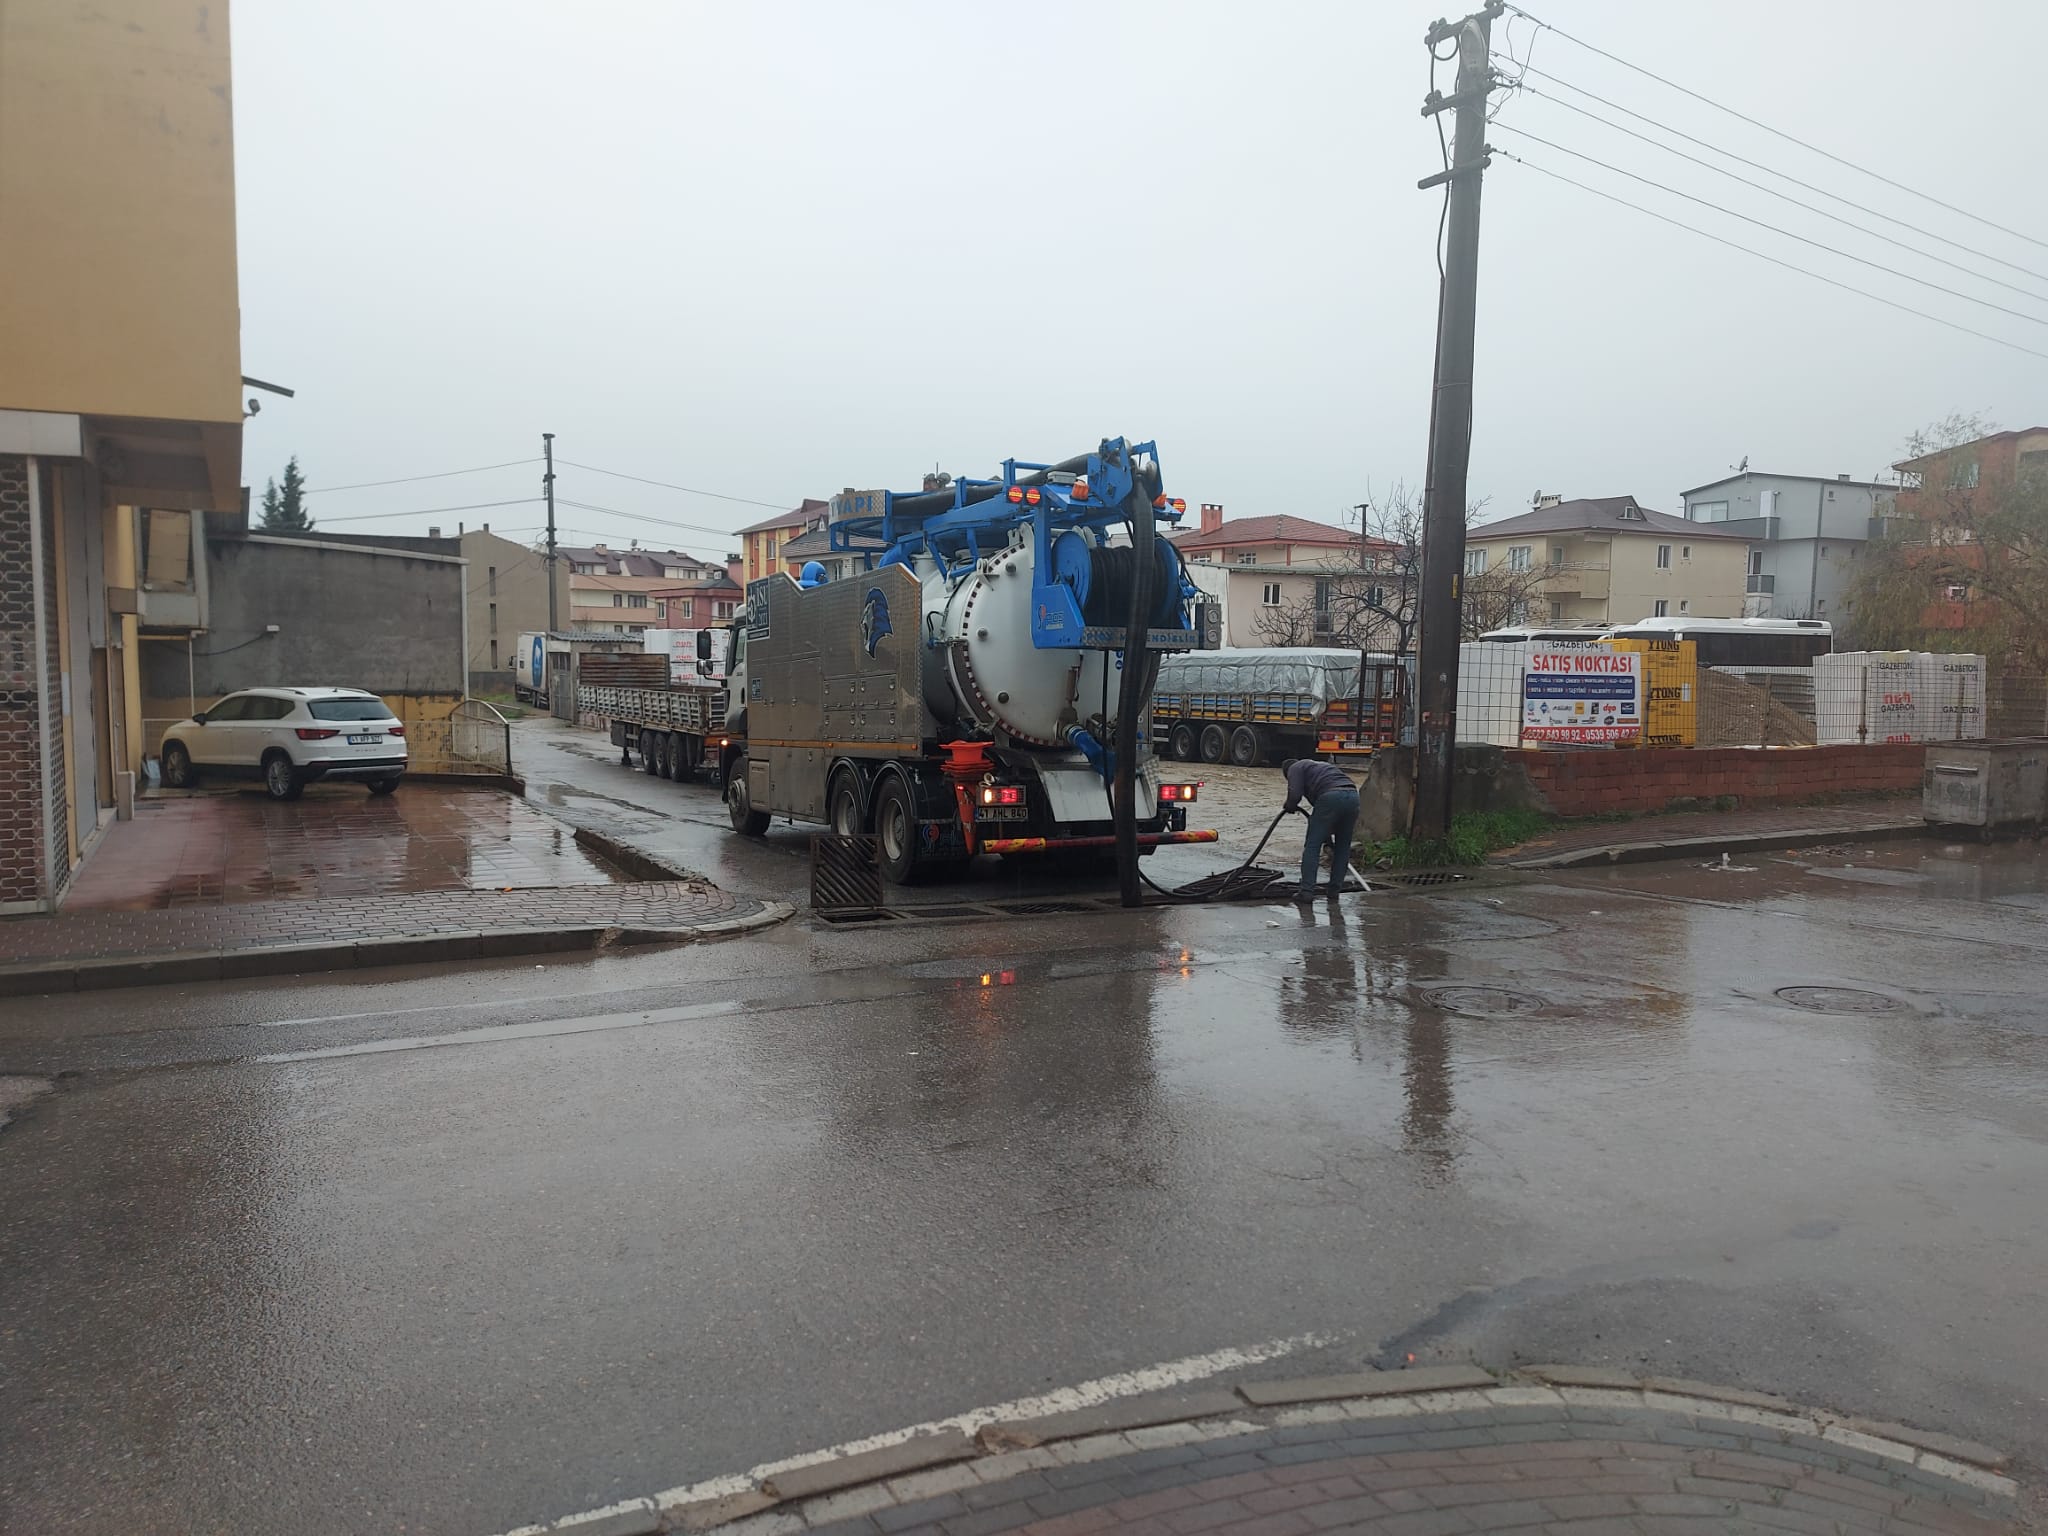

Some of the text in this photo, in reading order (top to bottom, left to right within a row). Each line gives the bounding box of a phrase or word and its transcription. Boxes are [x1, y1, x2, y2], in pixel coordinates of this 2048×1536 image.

[1648, 639, 1680, 651] YTONG
[1533, 655, 1632, 674] SATIŞ NOKTASI
[1649, 687, 1680, 698] YTONG
[1881, 703, 1915, 712] GAZBETON
[1561, 729, 1570, 740] 98
[1571, 729, 1581, 740] 92
[1585, 729, 1605, 741] 0539
[993, 808, 1007, 818] AHL
[1011, 807, 1026, 818] 840
